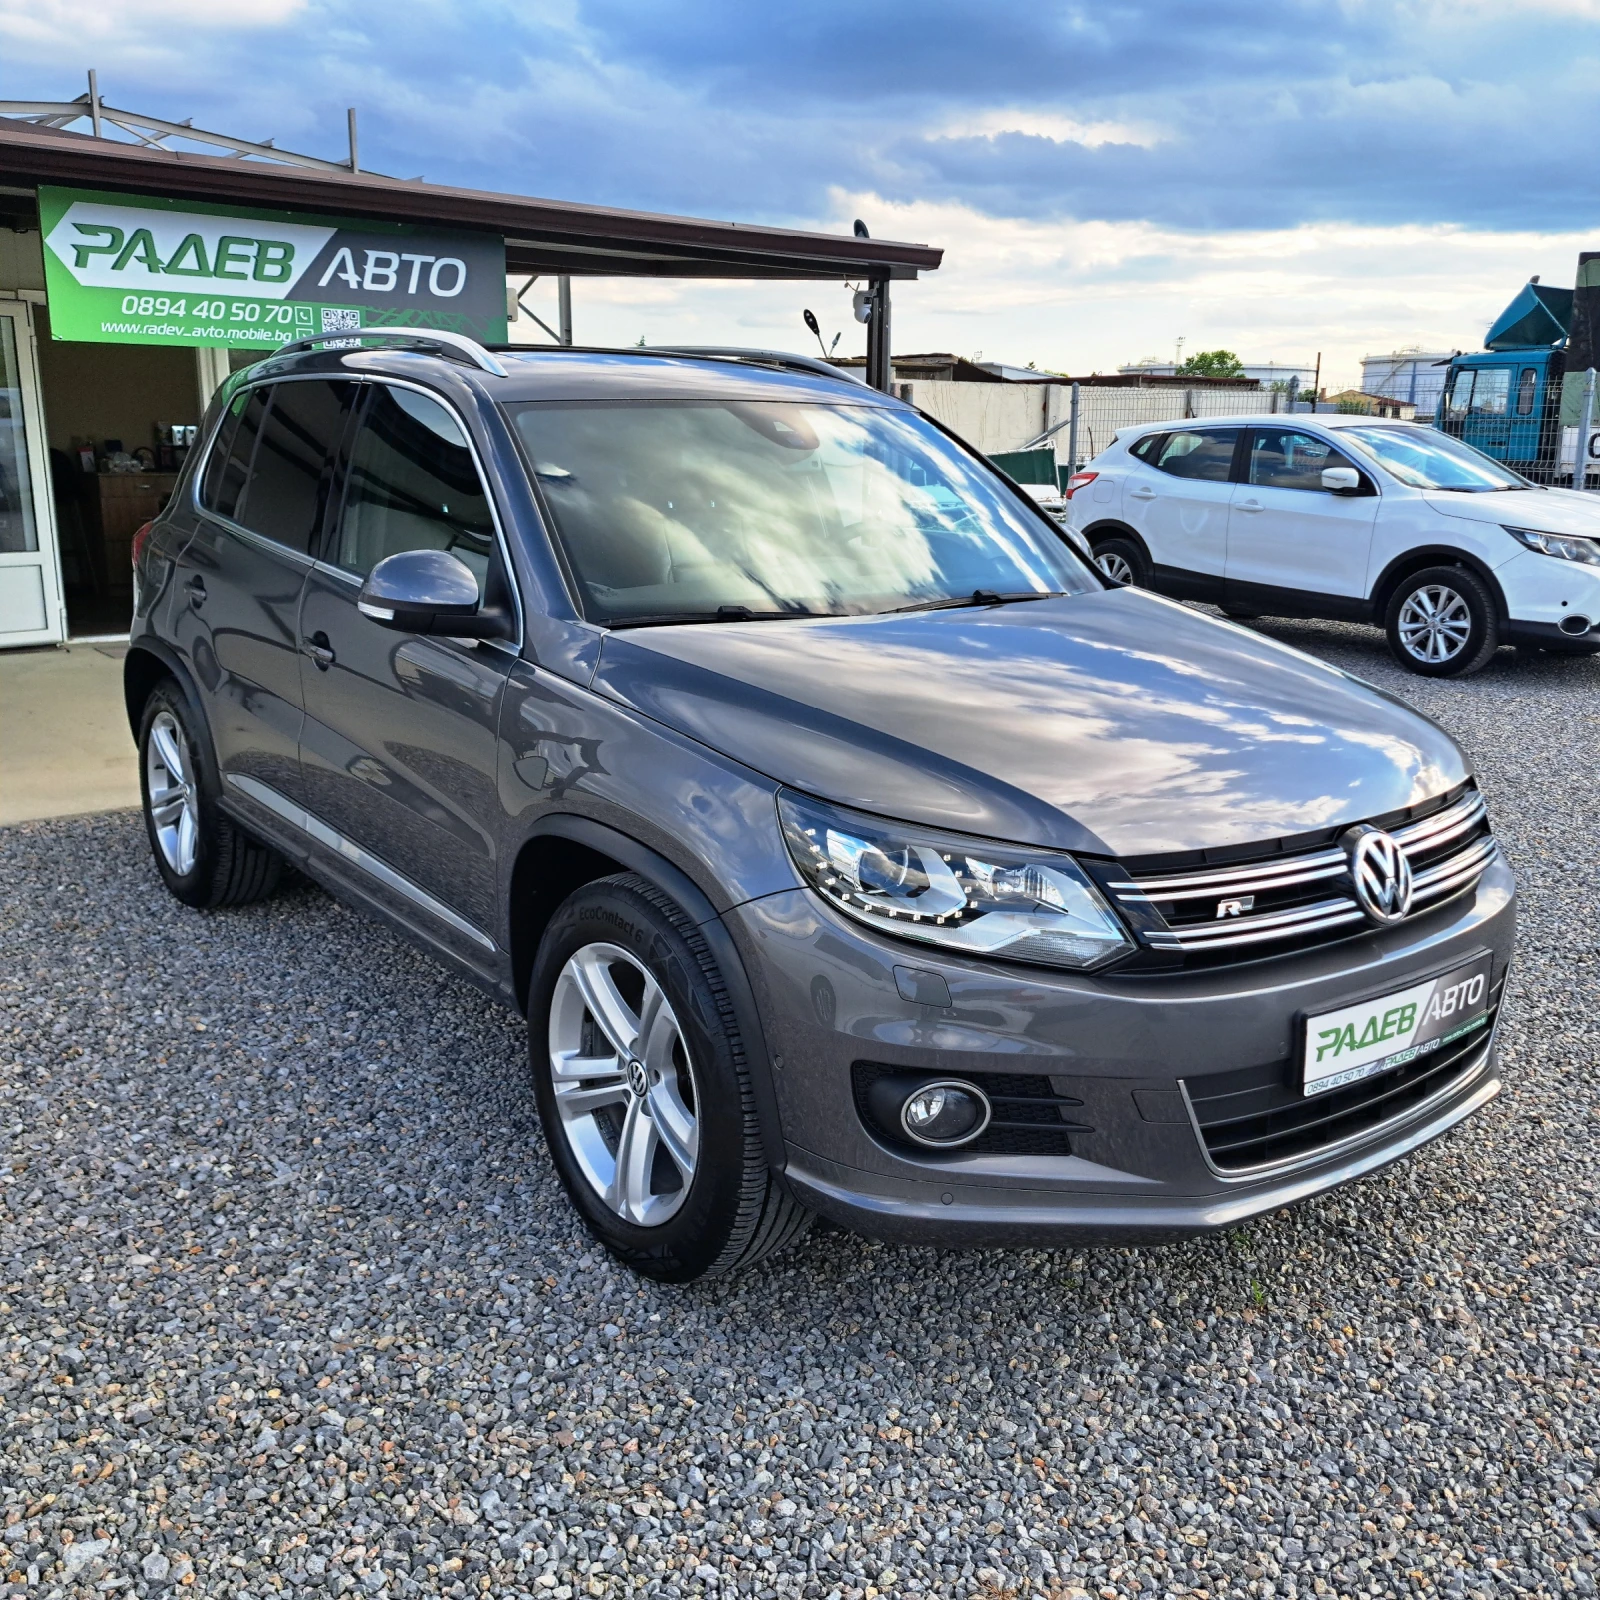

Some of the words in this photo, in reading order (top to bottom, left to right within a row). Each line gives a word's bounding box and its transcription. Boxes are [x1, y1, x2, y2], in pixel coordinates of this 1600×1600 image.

[318, 247, 467, 297] АВТО
[121, 295, 186, 317] 0894
[192, 300, 225, 320] 40
[229, 302, 260, 322] 50
[263, 304, 293, 324] 70
[101, 322, 292, 343] www.radev_avto.mobile.bg
[580, 906, 635, 936] EcoContact
[635, 929, 644, 942] 6
[1423, 973, 1485, 1025] АВТО
[1307, 1079, 1329, 1094] 0894
[1330, 1075, 1342, 1086] 40
[1343, 1071, 1354, 1082] 50
[1354, 1067, 1365, 1079] 70
